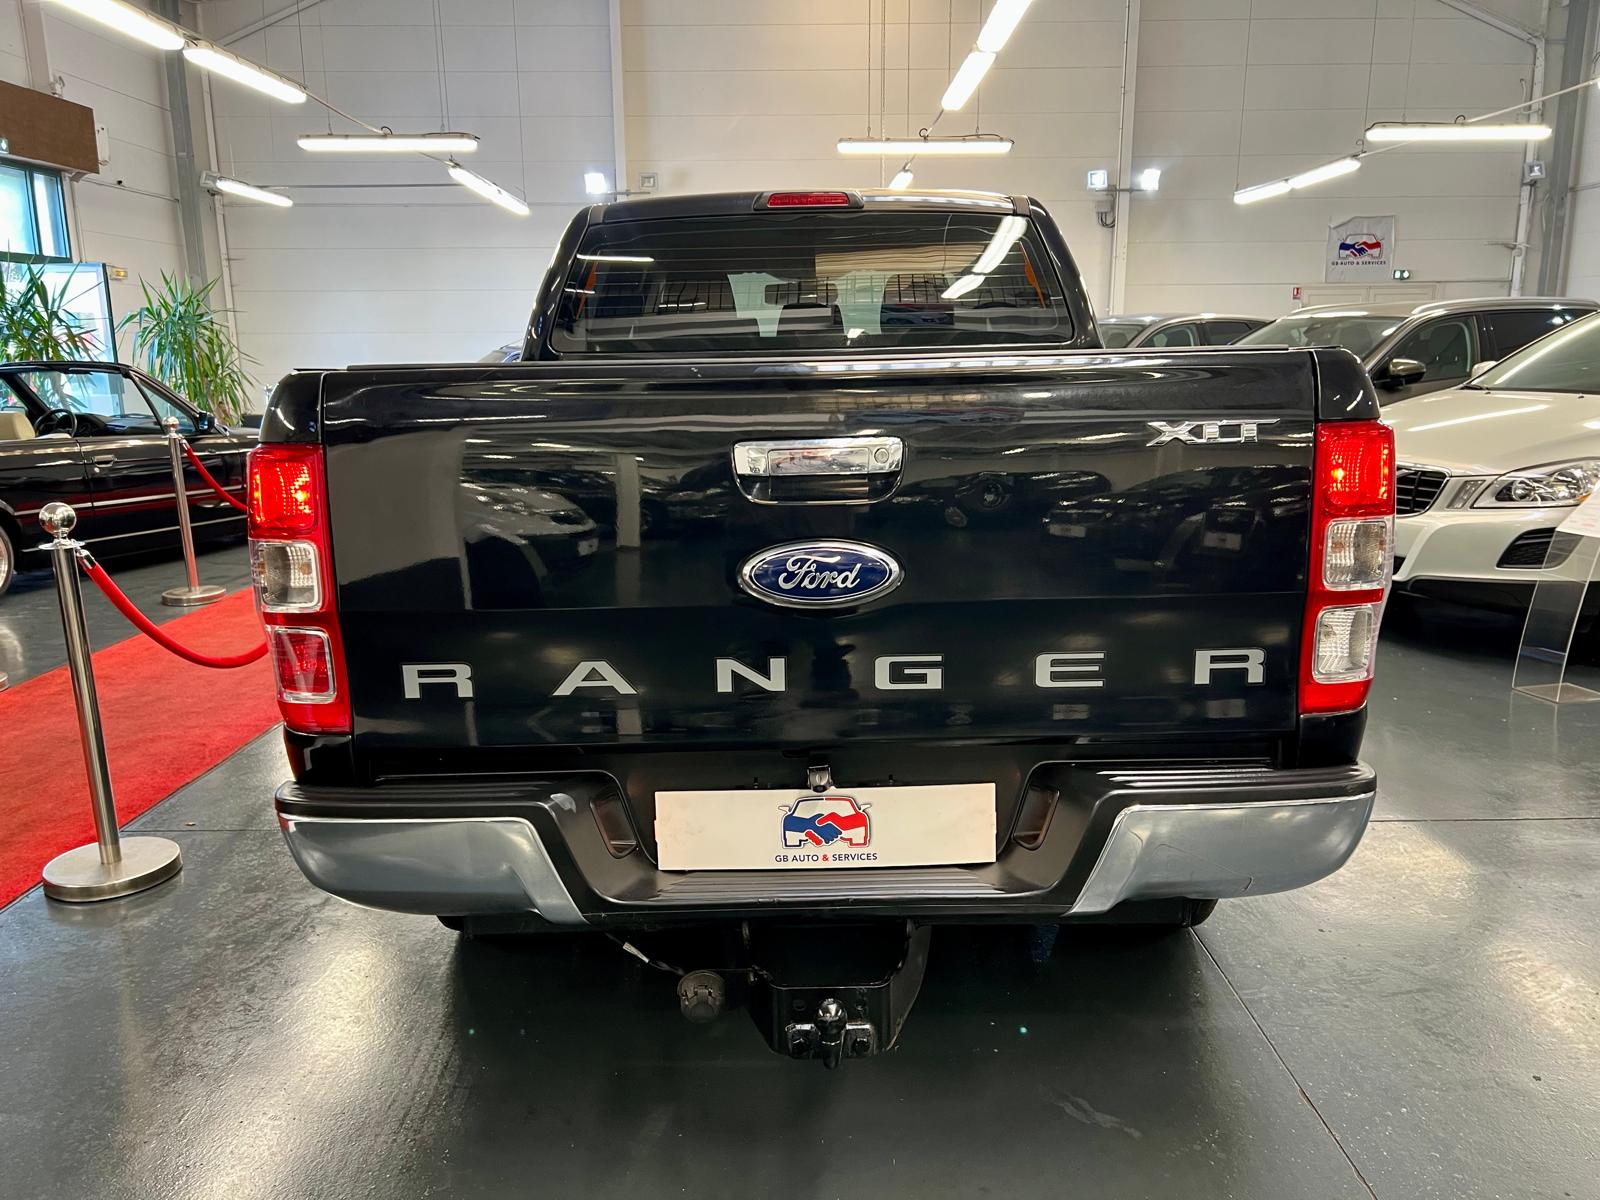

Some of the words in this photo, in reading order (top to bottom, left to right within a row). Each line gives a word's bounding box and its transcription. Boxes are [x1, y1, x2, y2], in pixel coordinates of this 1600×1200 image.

[1146, 418, 1280, 447] XLT
[778, 555, 861, 590] Ford
[401, 648, 1266, 699] RANGER
[791, 854, 819, 862] AUTO
[821, 854, 829, 862] &
[832, 853, 878, 862] SERVICES
